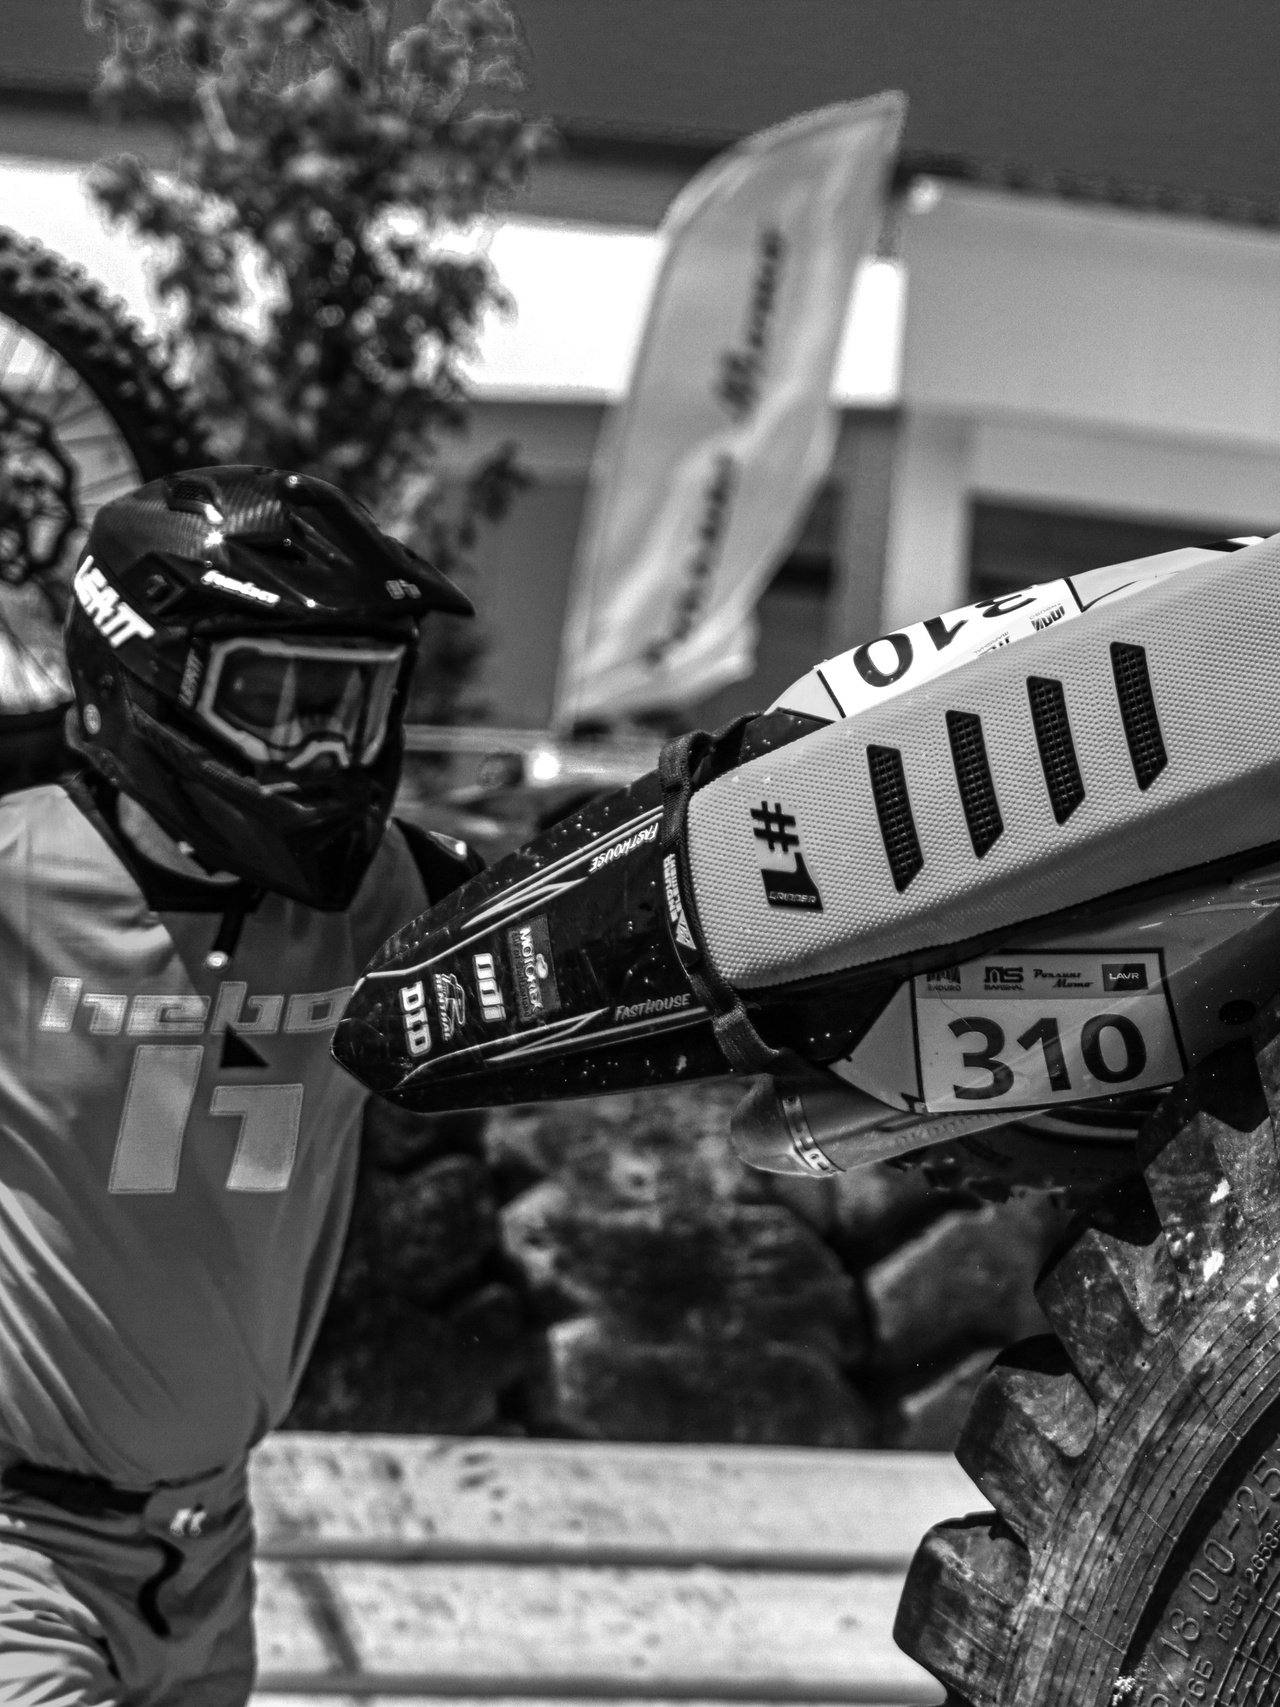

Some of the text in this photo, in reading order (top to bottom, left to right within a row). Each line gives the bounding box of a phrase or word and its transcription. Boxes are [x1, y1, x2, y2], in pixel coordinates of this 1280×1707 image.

[588, 822, 659, 874] FASTHOUSE
[519, 926, 544, 1012] MOTOREX
[927, 983, 962, 992] ENDURO
[1108, 971, 1140, 981] LAVR
[39, 976, 356, 1035] hebo
[434, 973, 453, 1042] RENTHAL
[613, 992, 692, 1022] FASTHOUSE
[947, 1013, 1148, 1100] 310
[1216, 1583, 1249, 1642] ГОСТ
